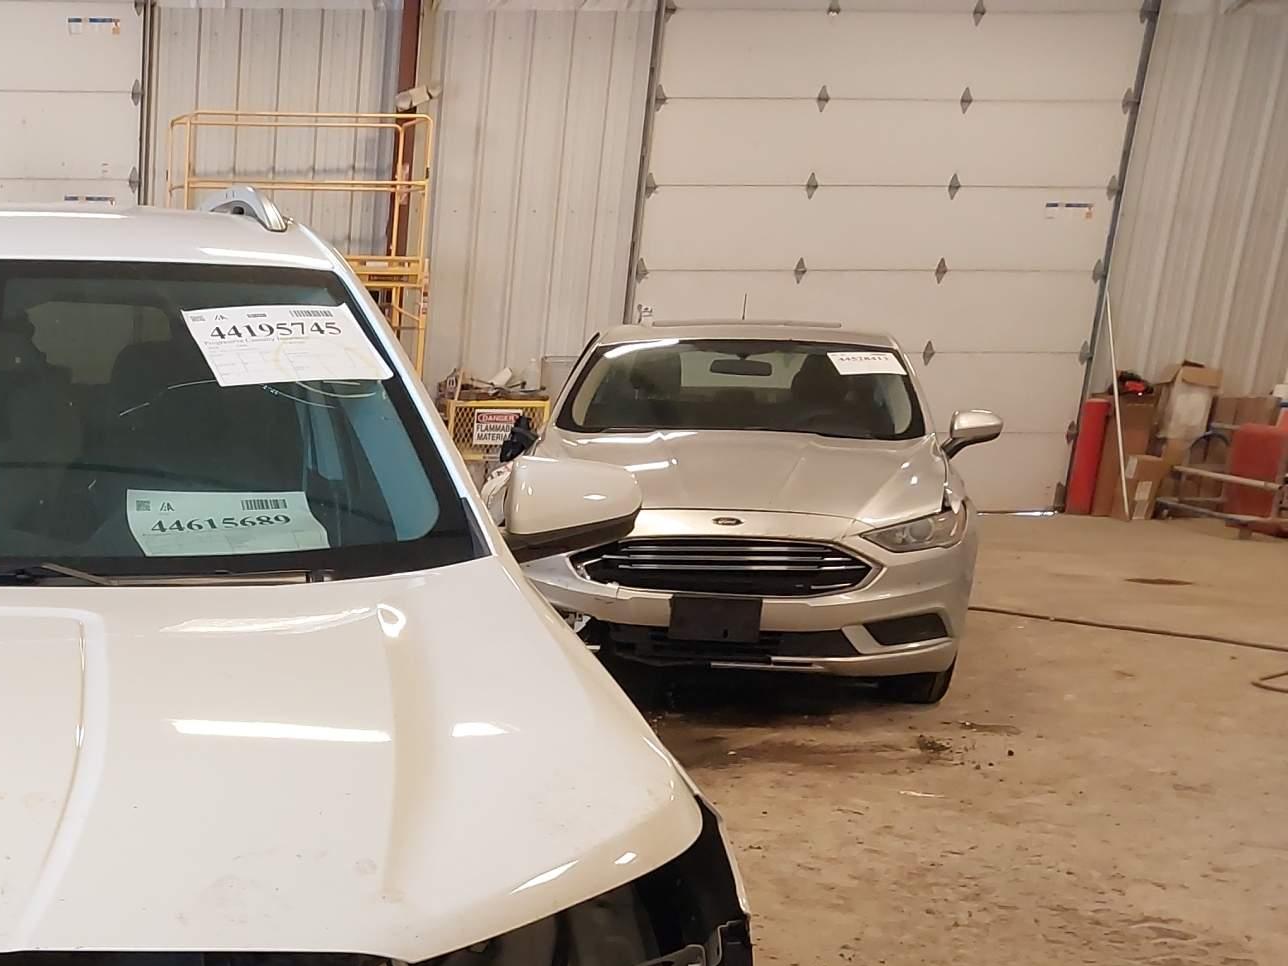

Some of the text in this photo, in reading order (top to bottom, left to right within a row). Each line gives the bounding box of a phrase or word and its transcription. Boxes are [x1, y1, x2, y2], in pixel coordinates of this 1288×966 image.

[210, 321, 342, 340] 44195745
[481, 414, 515, 422] DANGER
[476, 424, 511, 432] FLAMMAB
[476, 432, 509, 440] MATERIA
[151, 513, 292, 533] 44615689
